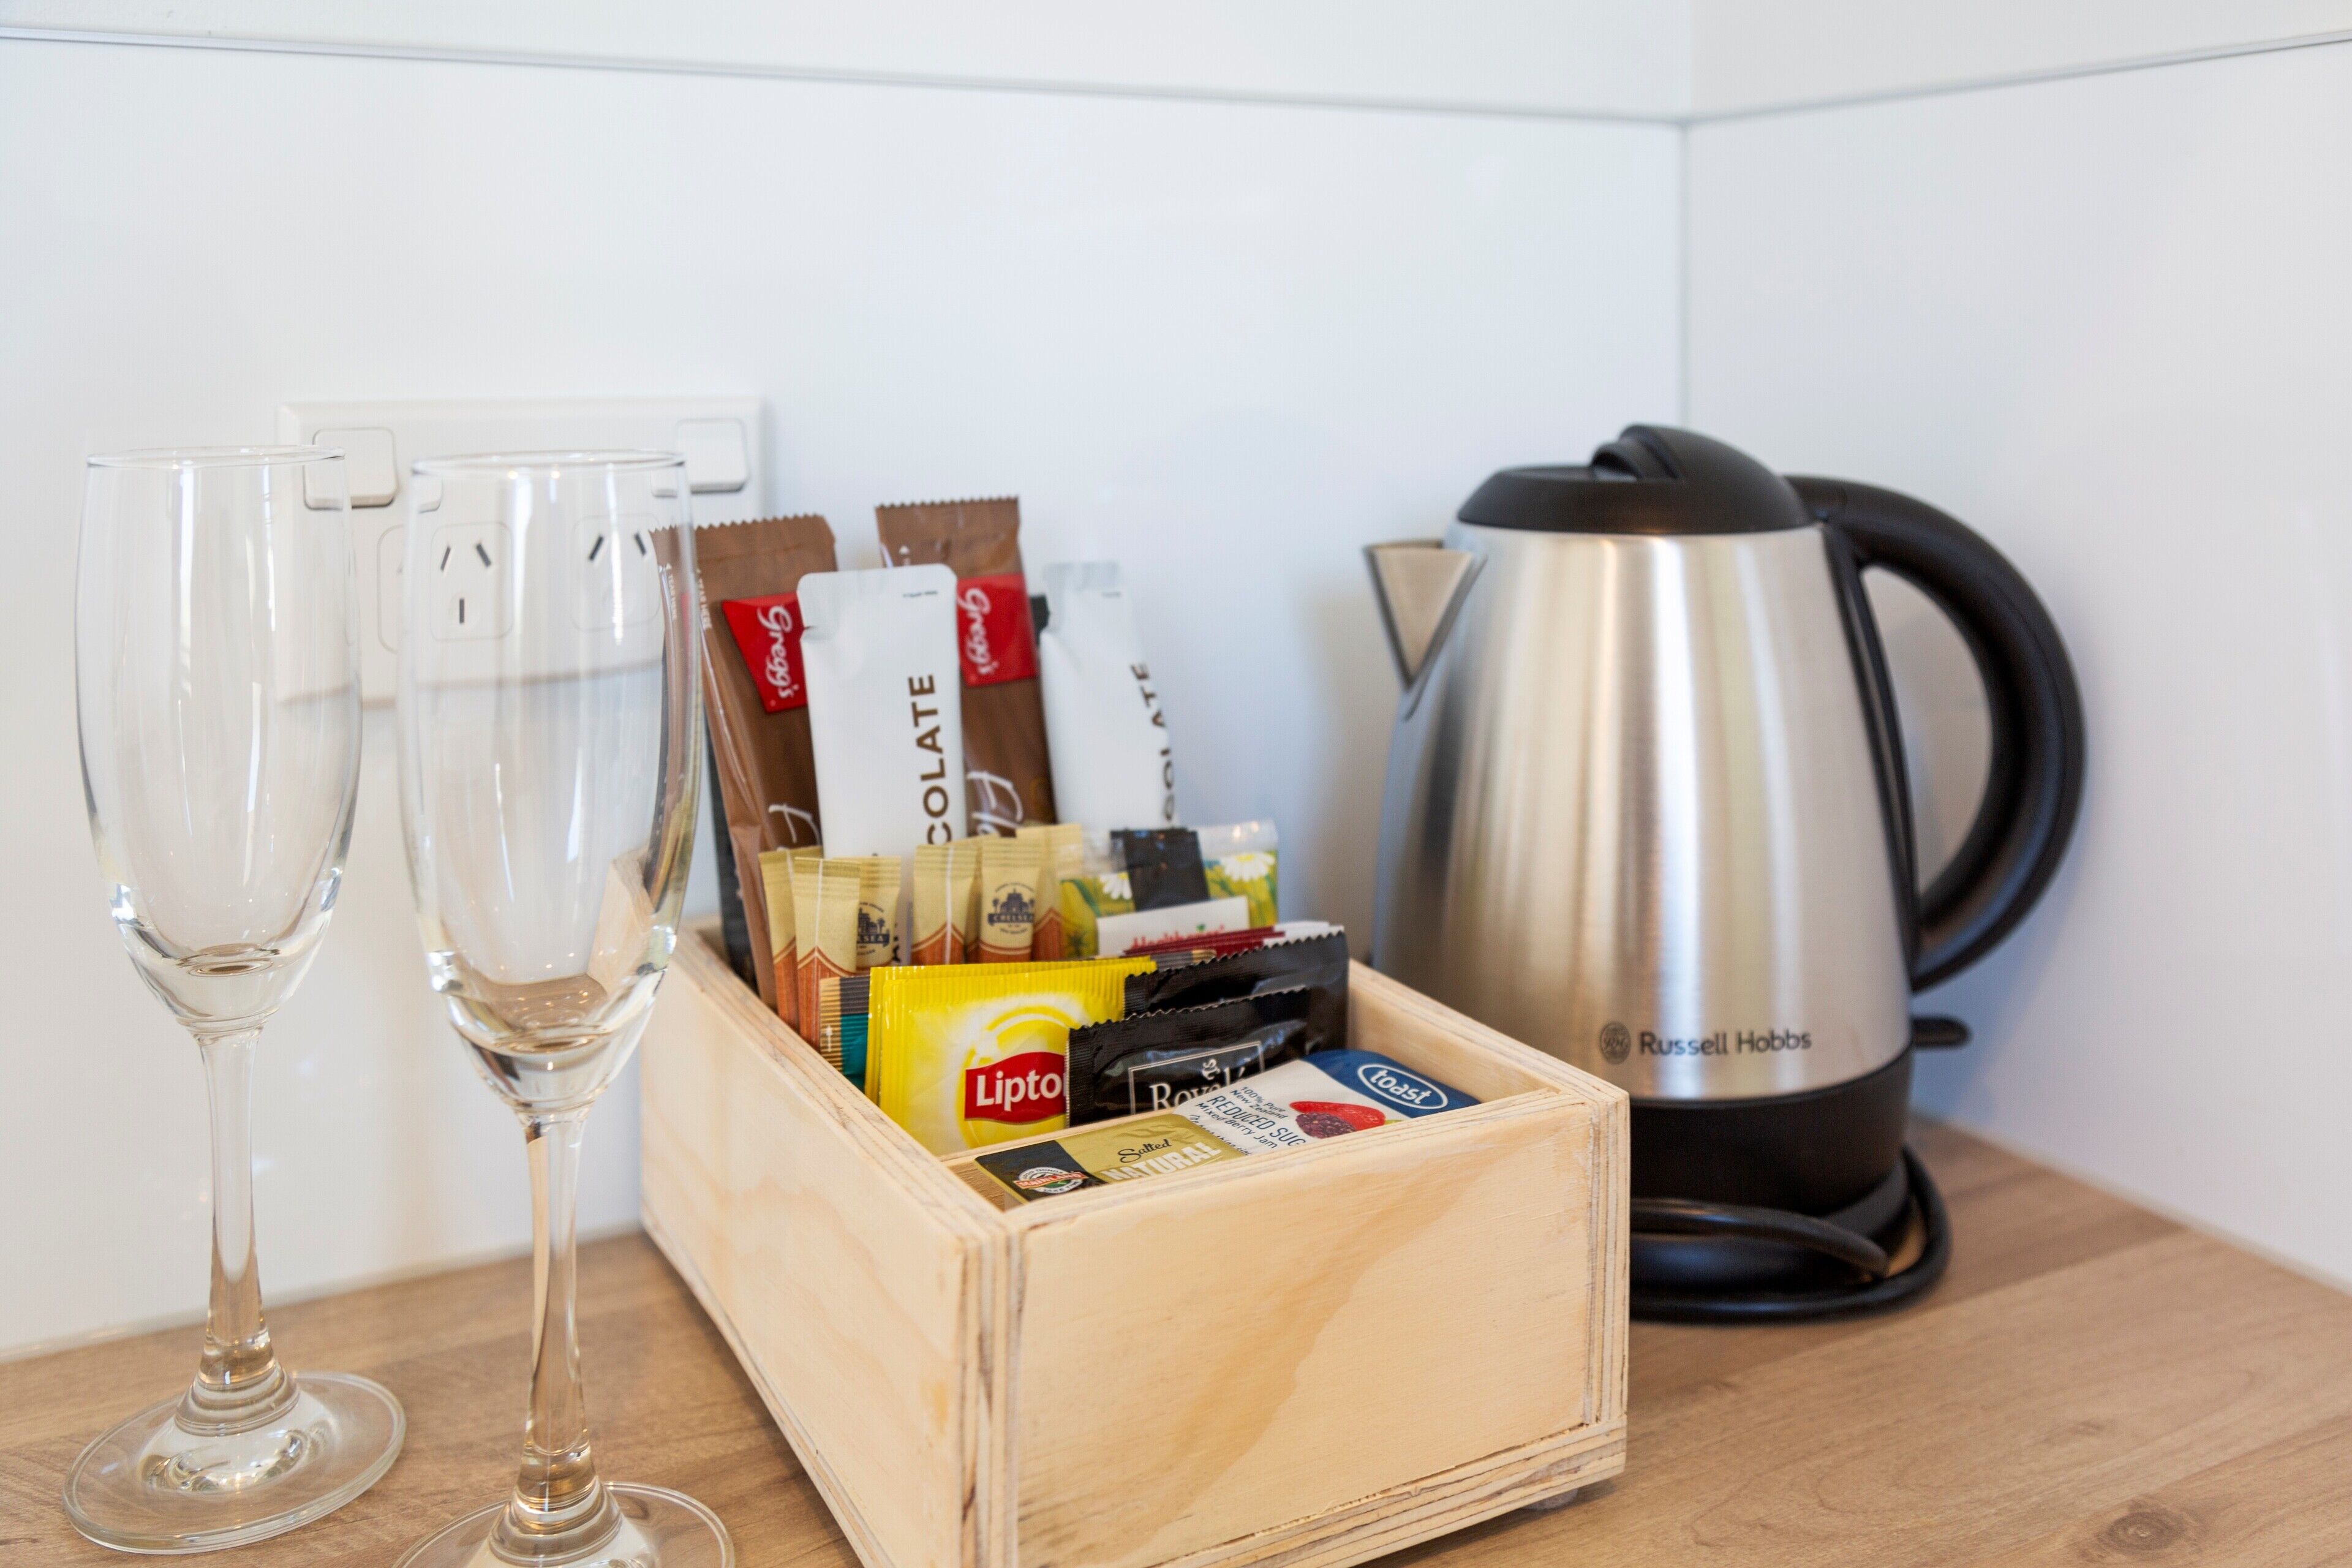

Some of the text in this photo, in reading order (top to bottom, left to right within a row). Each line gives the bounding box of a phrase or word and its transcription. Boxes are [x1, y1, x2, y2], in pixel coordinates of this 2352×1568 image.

[956, 588, 1000, 674] Gregg's
[756, 605, 799, 698] Gregg's
[908, 674, 952, 845] COLATE
[1638, 1031, 1728, 1055] Russell
[1735, 1026, 1812, 1054] Hobbs
[1241, 1087, 1286, 1113] 100% Pure
[1371, 1069, 1432, 1104] toast
[1207, 1095, 1276, 1130] REDUCED
[1230, 1090, 1288, 1119] New Zealand
[1196, 1102, 1226, 1121] Mixed
[1224, 1120, 1256, 1136] Berry
[1253, 1135, 1278, 1149] Jam
[1100, 1142, 1222, 1181] NATURAL
[1118, 1139, 1172, 1163] Salted
